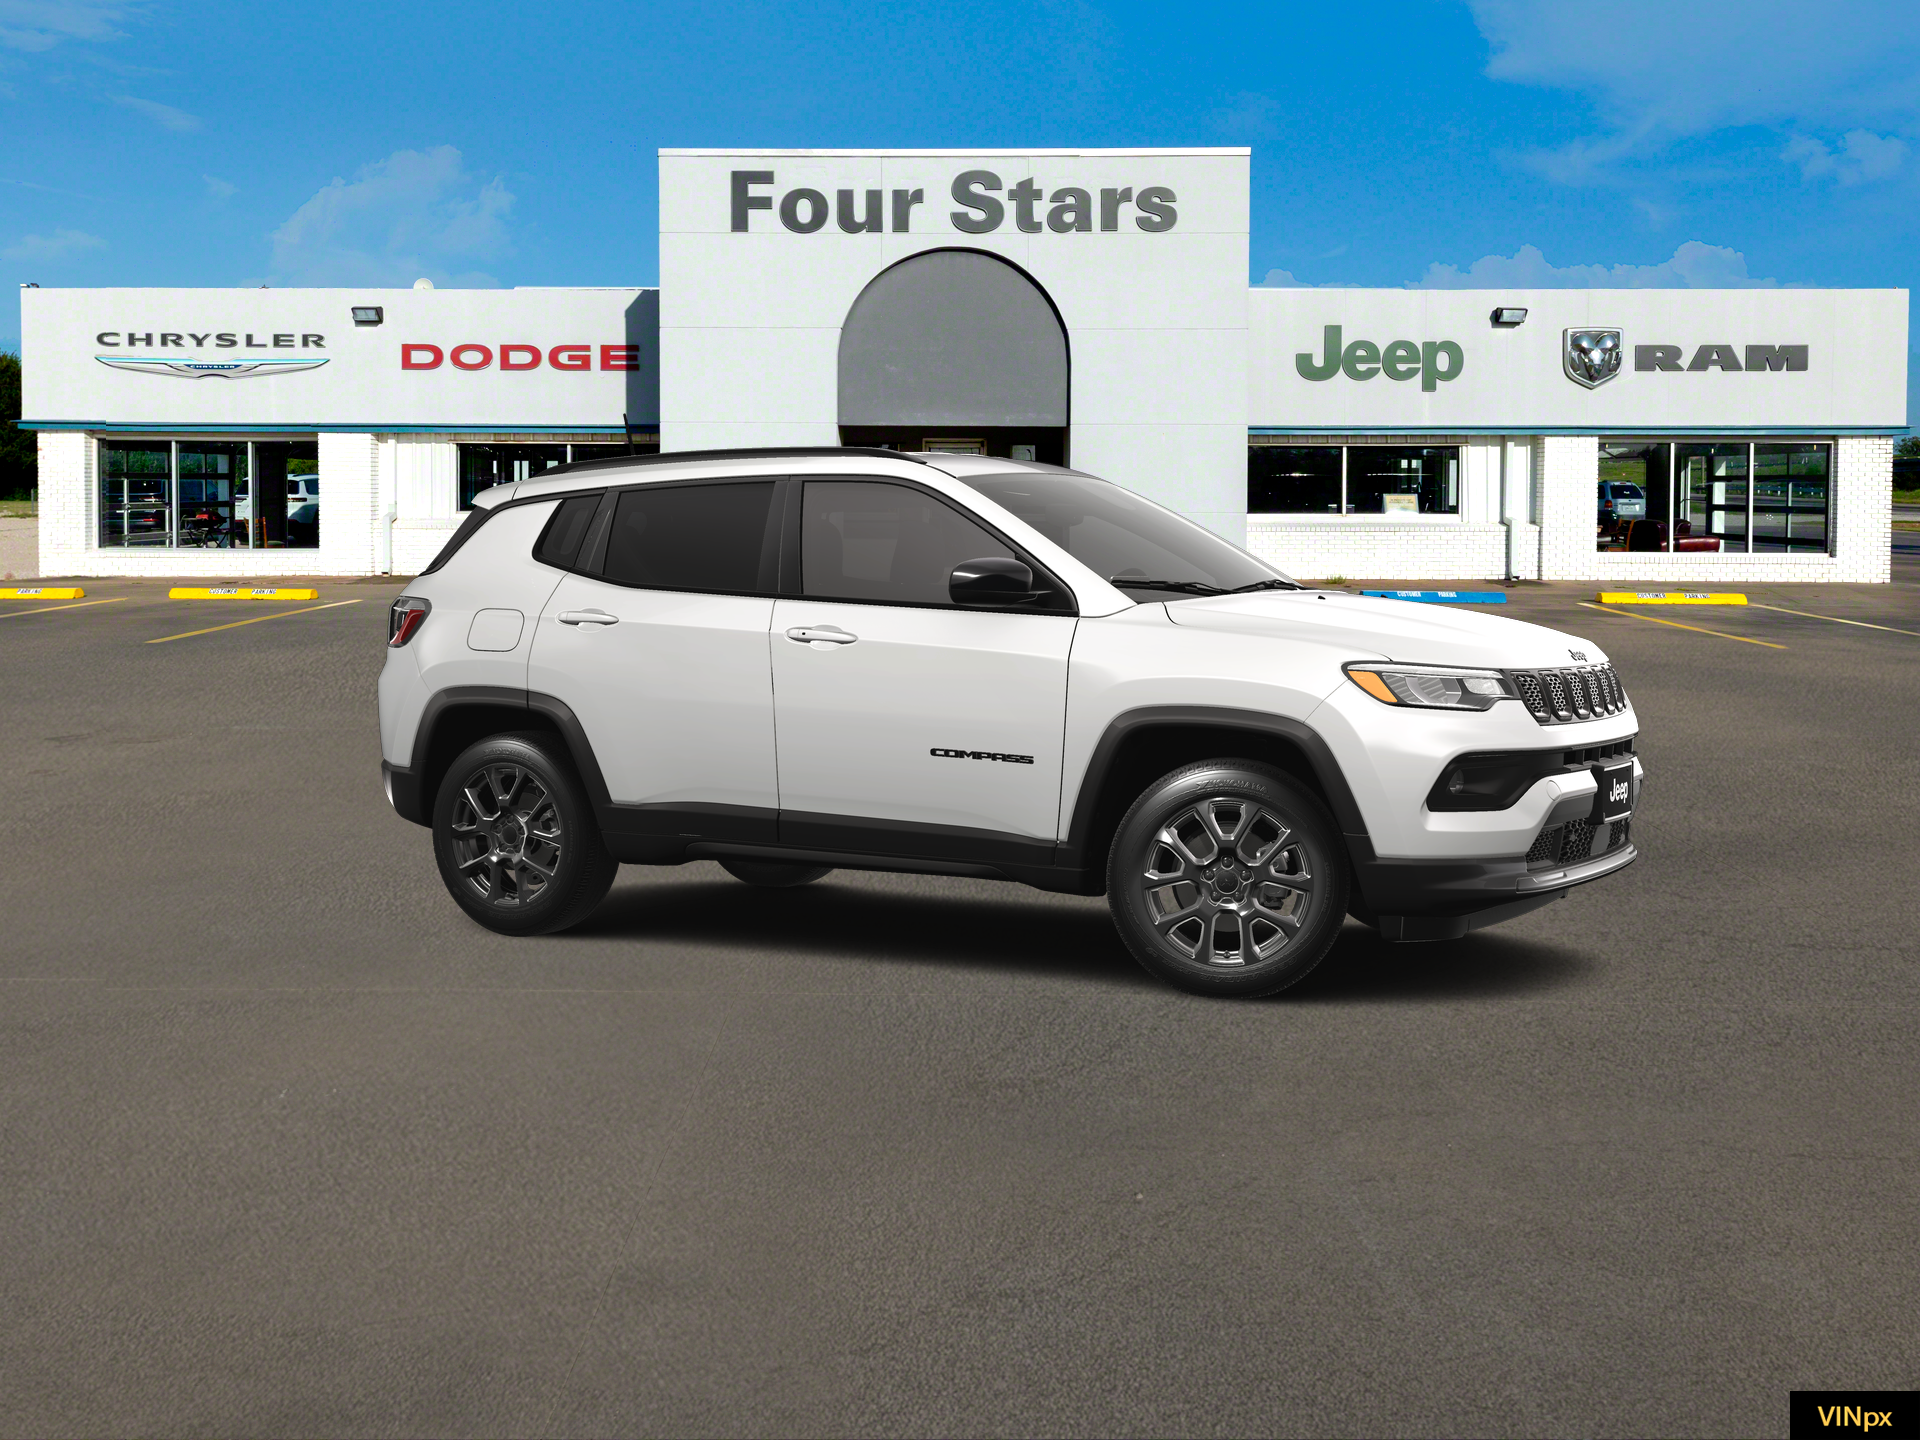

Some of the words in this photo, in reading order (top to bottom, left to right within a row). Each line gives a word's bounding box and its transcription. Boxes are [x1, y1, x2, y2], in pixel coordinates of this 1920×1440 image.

[730, 170, 924, 234] Four
[950, 169, 1178, 234] Stars
[96, 332, 326, 348] CHRYSLER
[401, 343, 640, 371] DODGE
[1295, 325, 1464, 392] Jeep
[1634, 344, 1809, 371] RAM
[930, 748, 1034, 765] COMPASS
[1610, 778, 1628, 803] Jeep
